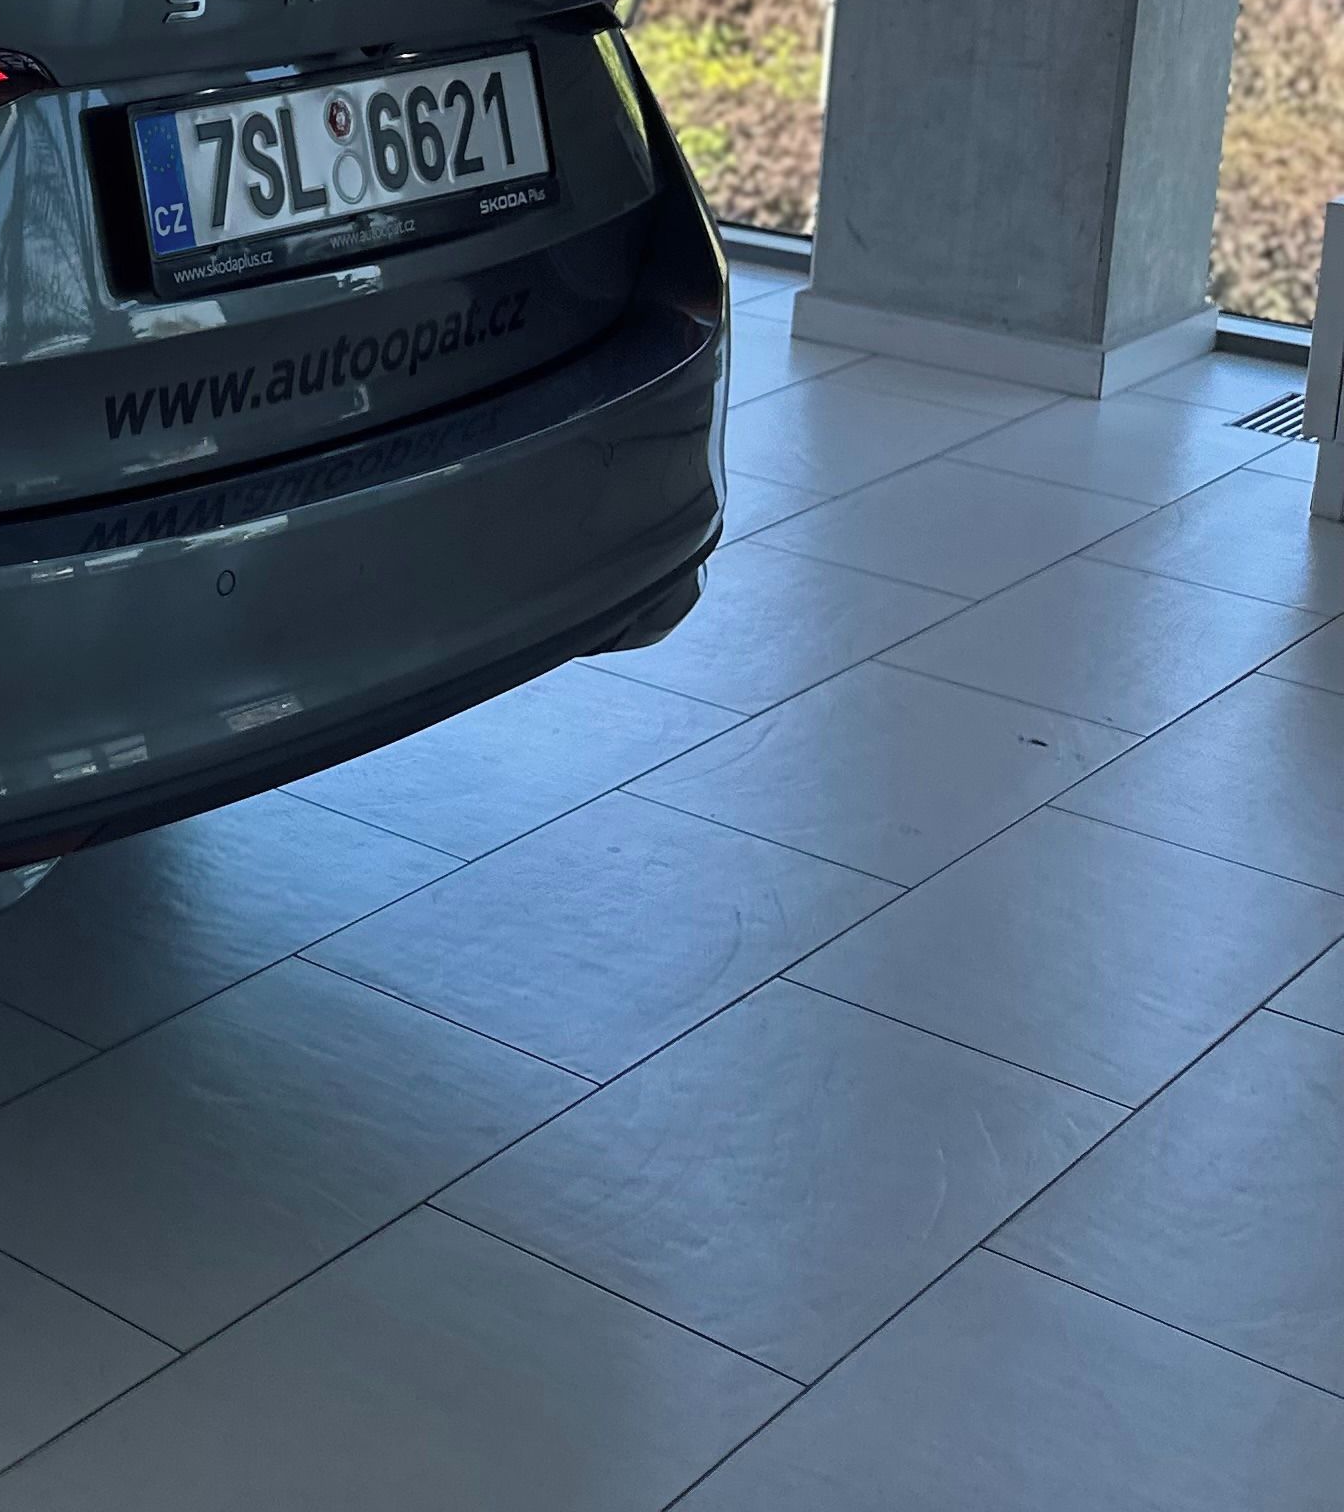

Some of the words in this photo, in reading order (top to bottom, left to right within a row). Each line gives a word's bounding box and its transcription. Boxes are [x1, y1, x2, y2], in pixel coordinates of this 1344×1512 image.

[154, 203, 187, 238] CZ
[196, 107, 329, 229] 7SL
[366, 71, 518, 192] 6621
[173, 251, 274, 285] www.skodaplus.cz
[105, 291, 531, 441] www.autoopat.cz
